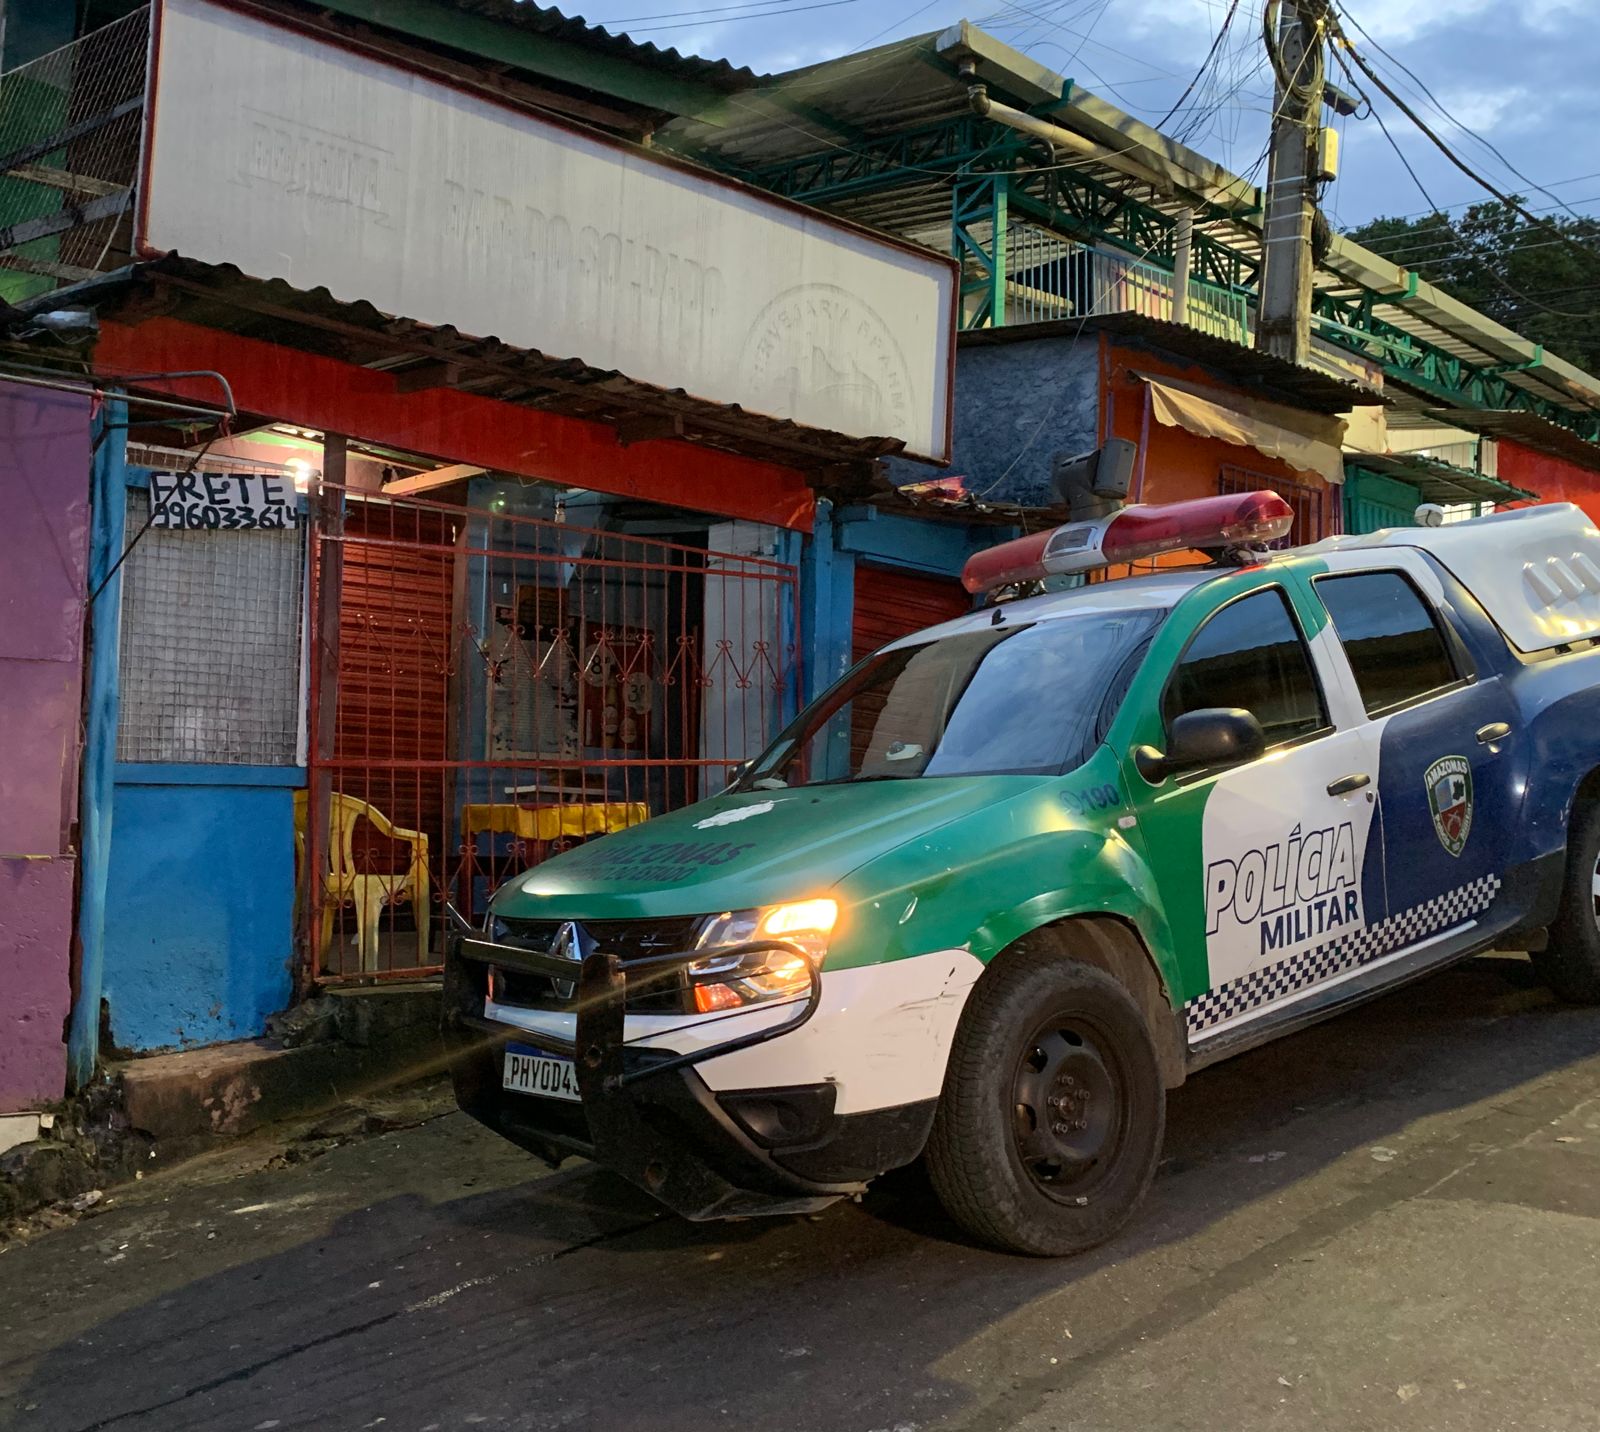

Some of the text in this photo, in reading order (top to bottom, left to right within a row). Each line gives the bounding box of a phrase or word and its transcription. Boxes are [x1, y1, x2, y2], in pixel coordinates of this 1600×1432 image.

[151, 471, 285, 505] FRETE
[153, 502, 298, 529] 996033614
[1427, 759, 1468, 789] AMAZONAS
[1081, 784, 1119, 810] 190
[1206, 822, 1356, 936] POLÍCIA
[1260, 890, 1359, 956] MILITAR
